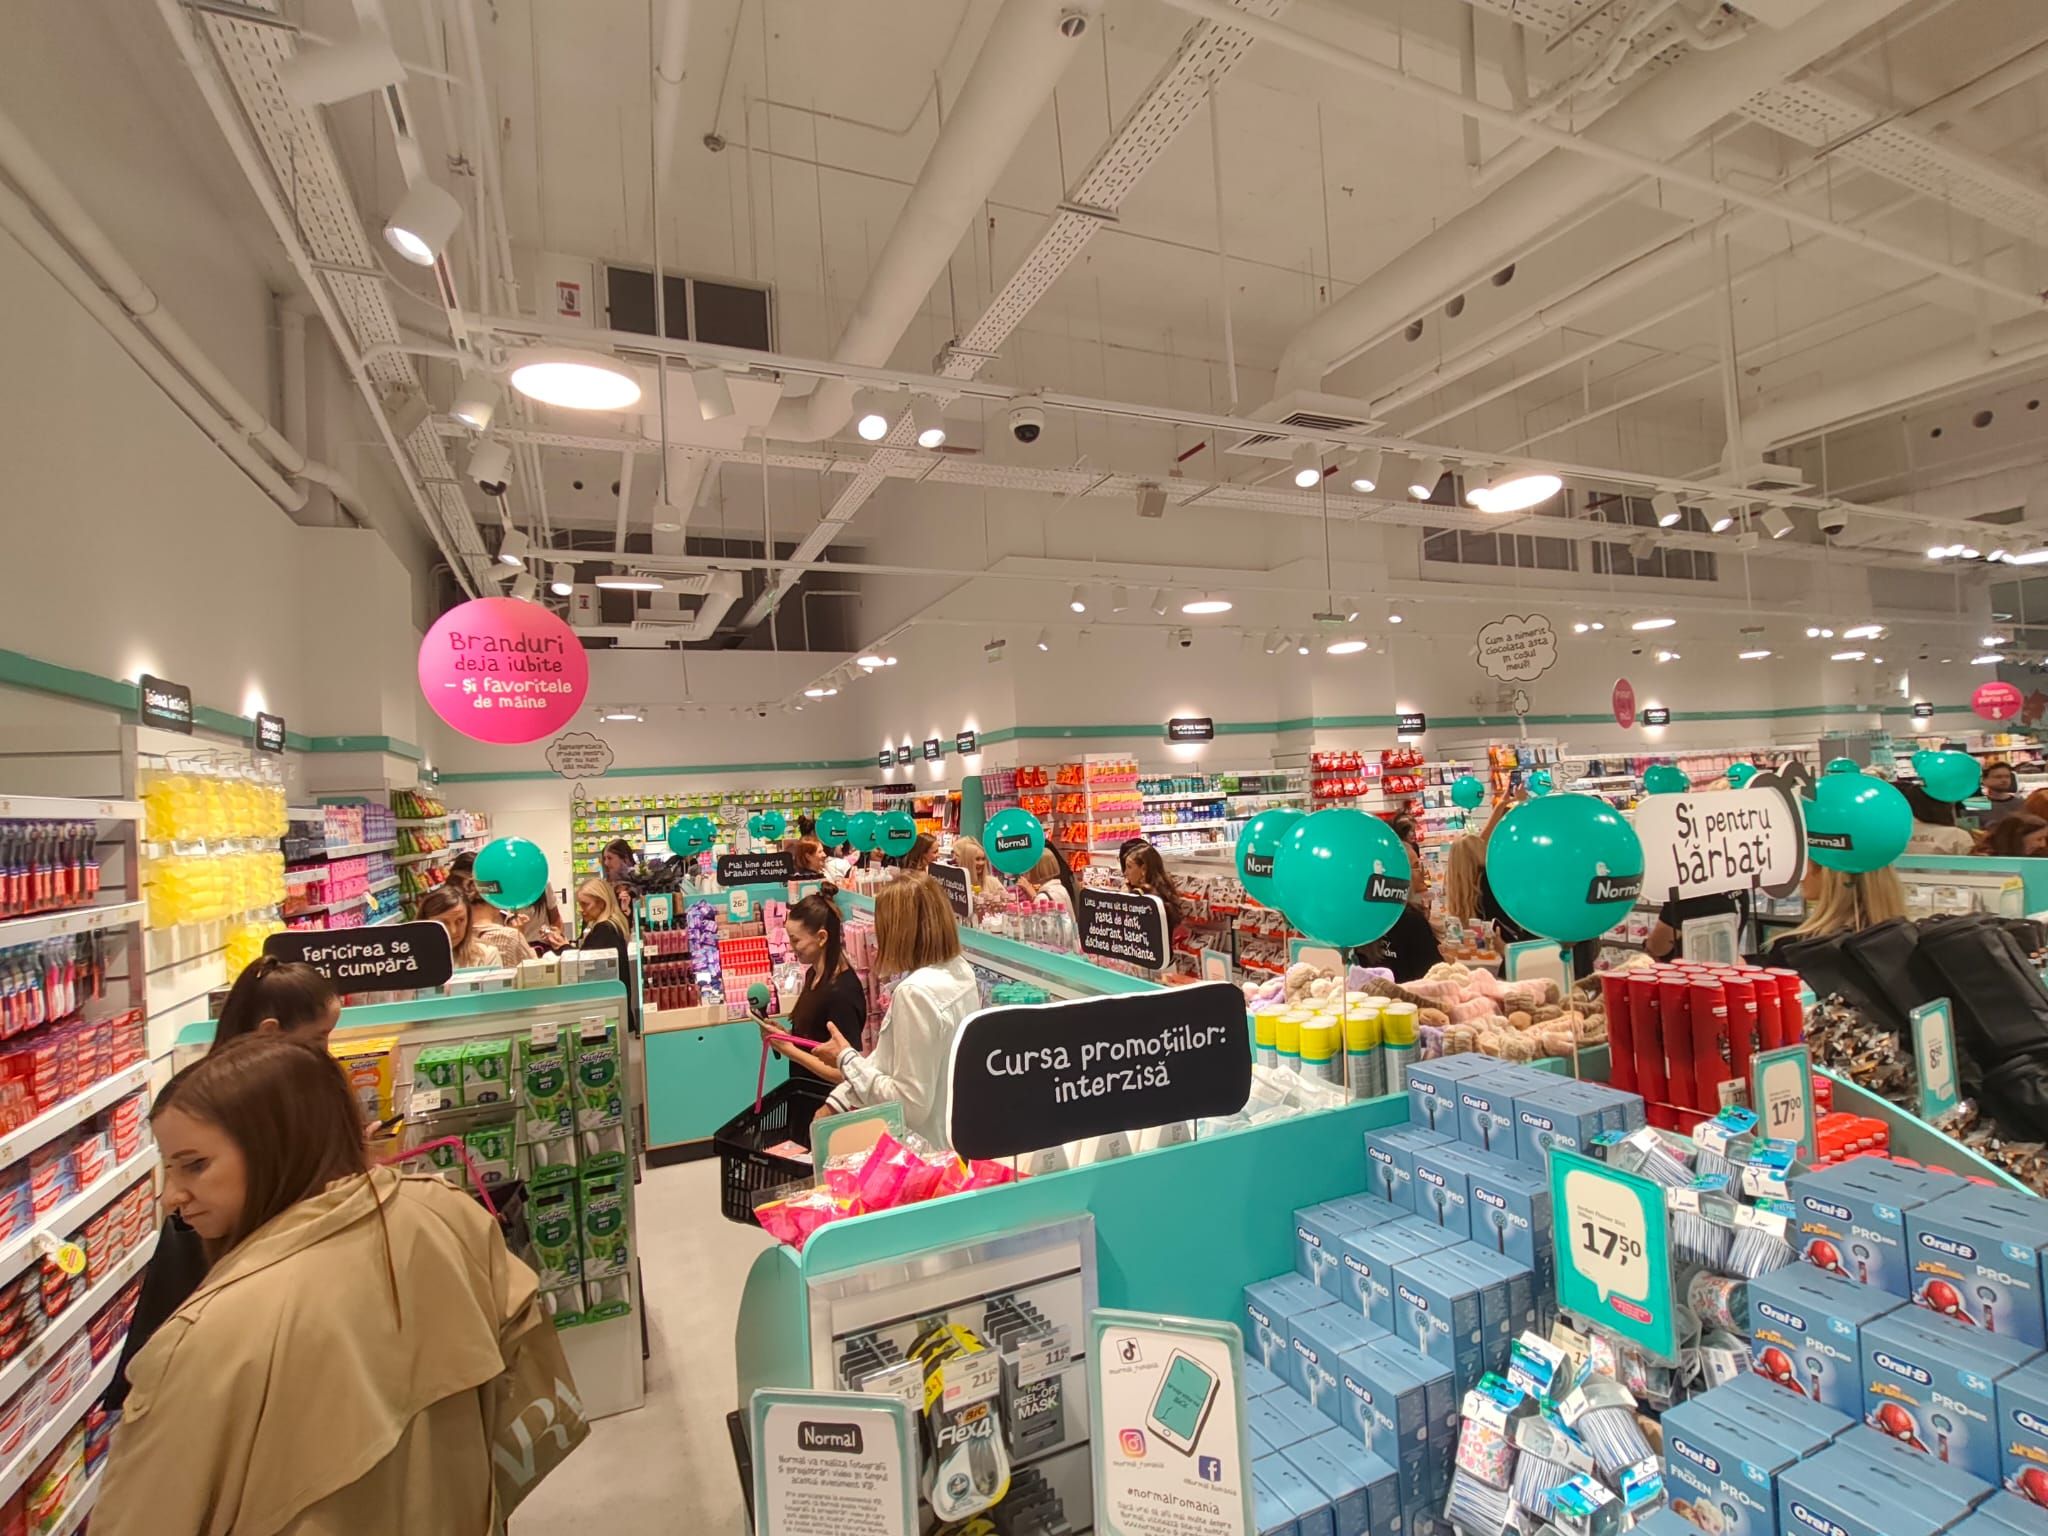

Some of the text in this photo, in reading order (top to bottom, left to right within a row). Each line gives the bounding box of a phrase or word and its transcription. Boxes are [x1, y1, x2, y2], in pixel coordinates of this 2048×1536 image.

[449, 631, 564, 655] Branduri
[1485, 636, 1504, 645] Cum
[1506, 634, 1513, 642] a
[455, 654, 563, 673] deja iubite
[483, 677, 573, 694] favoritele
[473, 694, 547, 709] de mâine
[1675, 802, 1772, 847] Și pentru
[998, 836, 1029, 850] Normal
[1807, 837, 1845, 848] ormal
[728, 860, 742, 869] Mai
[1672, 833, 1773, 886] bărbați
[724, 867, 788, 878] branduri scumpe
[1372, 879, 1410, 901] Norma
[1095, 912, 1113, 924] pastă
[1114, 913, 1122, 925] de
[1089, 923, 1123, 941] deodorant,
[302, 941, 410, 962] Fericirea se
[1085, 936, 1110, 951] dischete
[338, 956, 418, 978] cumpără
[986, 1024, 1227, 1077] Cursa promoțiilor:
[1055, 1061, 1171, 1104] interzisă
[1411, 1080, 1434, 1094] Oral-B
[1463, 1096, 1489, 1111] Oral-B
[1522, 1113, 1551, 1129] Oral-B
[1370, 1148, 1391, 1163] Oral-B
[1418, 1168, 1444, 1186] Oral-B
[1476, 1189, 1504, 1209] Oral-B
[1804, 1197, 1849, 1220] Oral-B
[1879, 1206, 1897, 1220] 3+
[1298, 1227, 1320, 1246] Oral-B
[1581, 1222, 1642, 1267] 17,50
[1851, 1225, 1882, 1244] PRO
[1921, 1233, 1973, 1259] Oral-B
[2008, 1247, 2030, 1260] 3+
[1345, 1255, 1369, 1275] Oral-B
[1976, 1264, 2012, 1286] PRO
[1400, 1287, 1426, 1309] Oral-B
[1249, 1305, 1269, 1327] Oral-B
[1760, 1304, 1803, 1330] Oral-B
[1833, 1321, 1851, 1334] 3+
[1294, 1339, 1317, 1363] Oral-B
[1805, 1337, 1836, 1358] PRO
[1876, 1354, 1930, 1384] Oral-B
[1345, 1378, 1371, 1403] Oral-B
[1966, 1374, 1987, 1390] 3+
[1013, 1384, 1060, 1409] PEEL-OFF
[1931, 1391, 1968, 1416] PRO
[1018, 1398, 1058, 1420] MASK
[804, 1425, 857, 1448] Normal
[937, 1417, 993, 1448] Flex4
[1675, 1440, 1718, 1472] Oral-B
[1748, 1466, 1766, 1482] 3+
[1127, 1487, 1220, 1516] #normalromania
[1720, 1480, 1750, 1505] PRO
